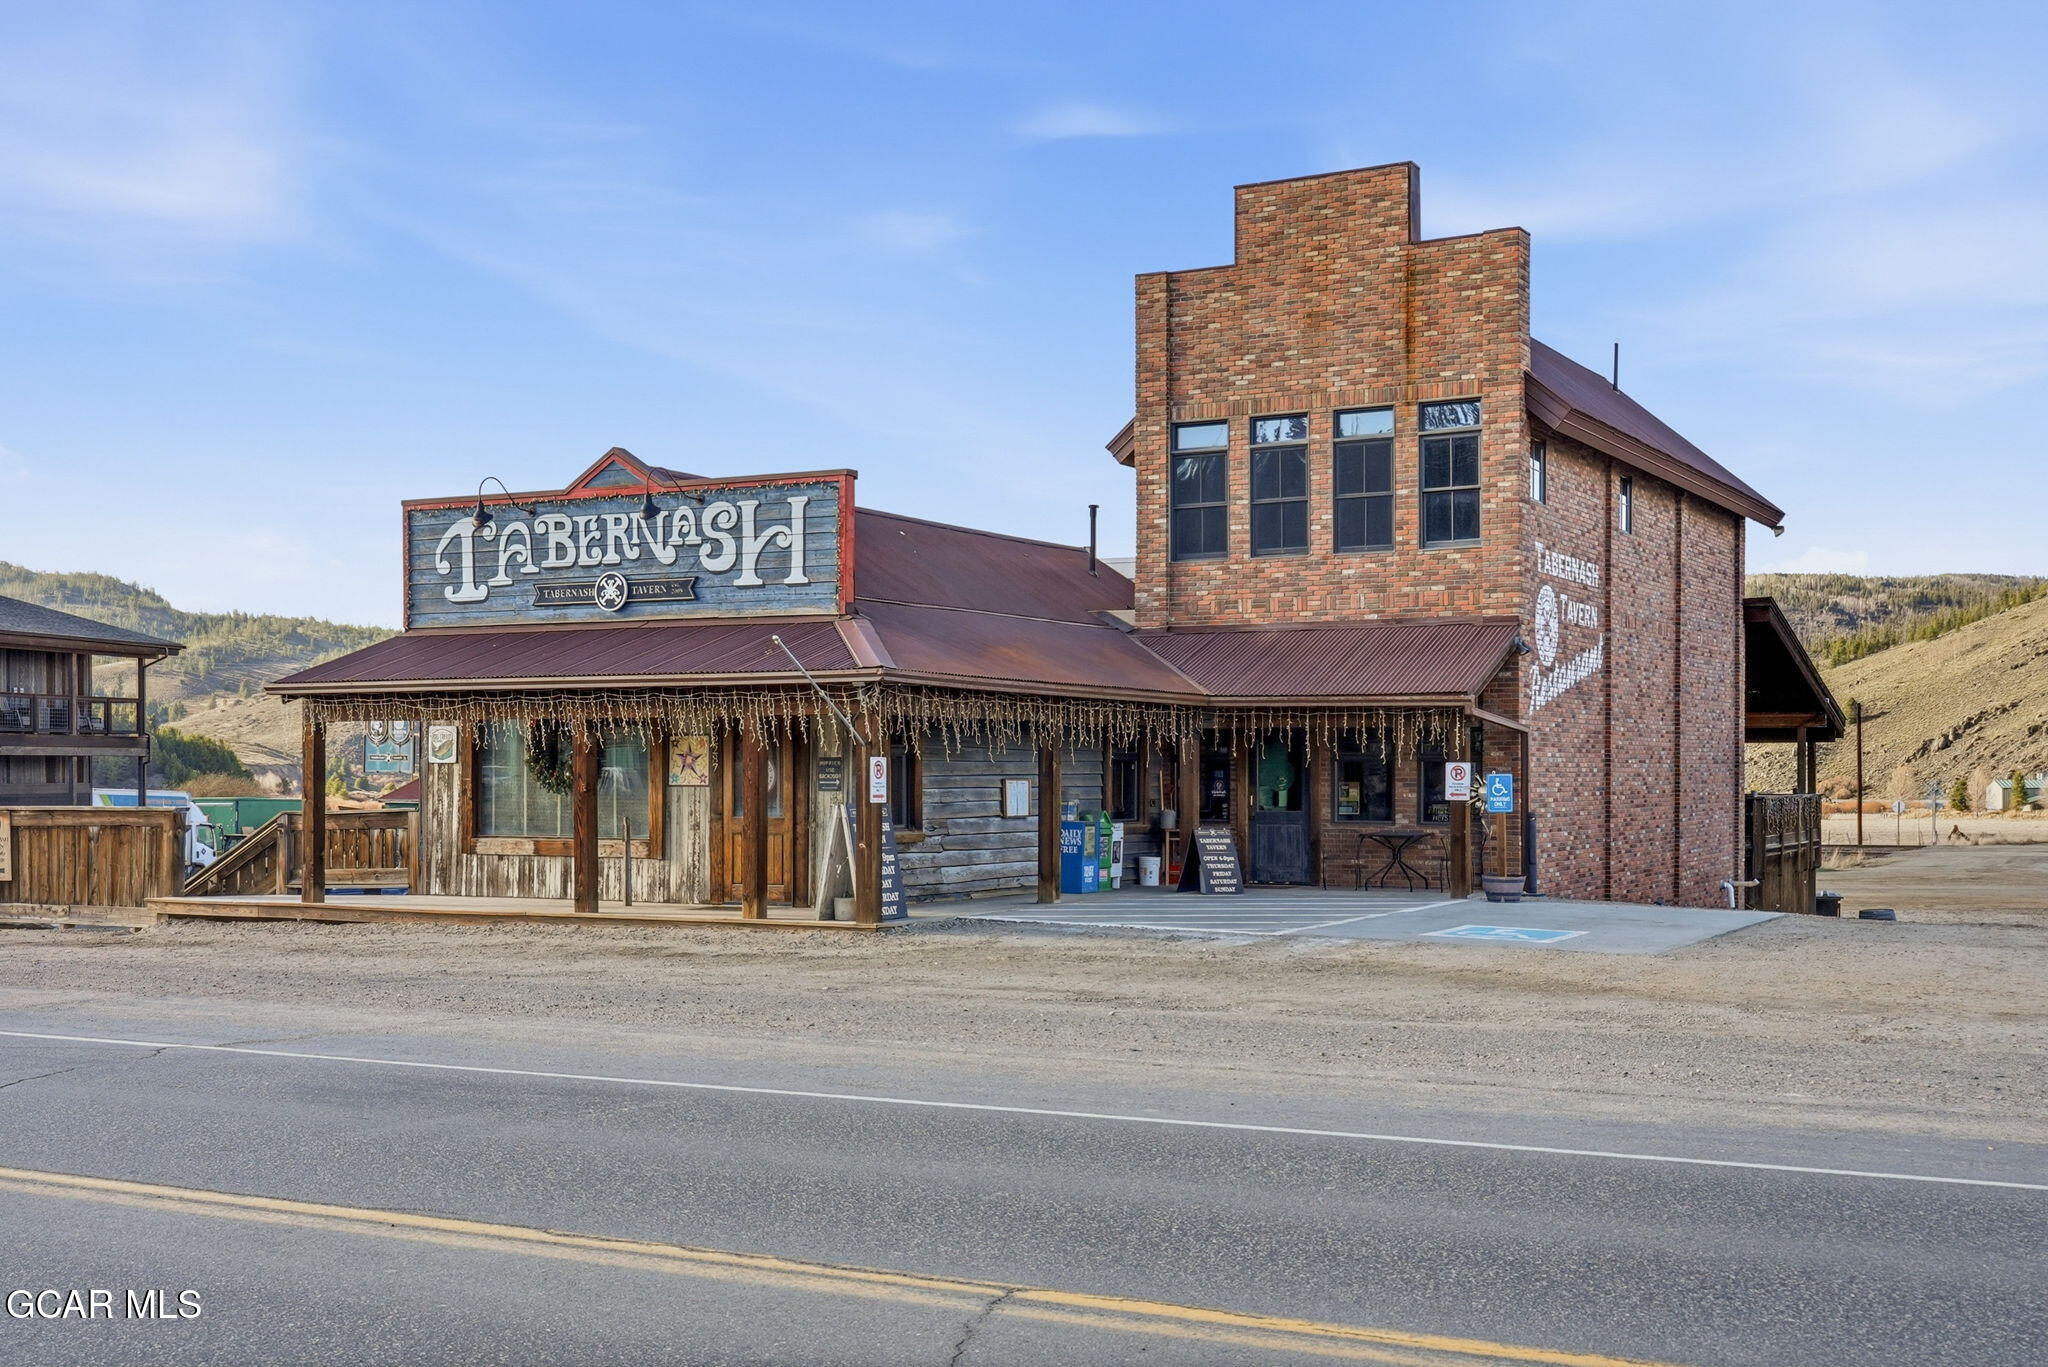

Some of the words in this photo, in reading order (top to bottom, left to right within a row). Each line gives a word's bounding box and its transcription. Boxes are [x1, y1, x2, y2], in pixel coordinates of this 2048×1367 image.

[434, 496, 810, 603] TABERNASH
[1535, 541, 1599, 588] TABERNASH
[543, 587, 595, 599] TABERNASH
[631, 583, 667, 594] TAVERN
[1560, 593, 1599, 630] TAVERN
